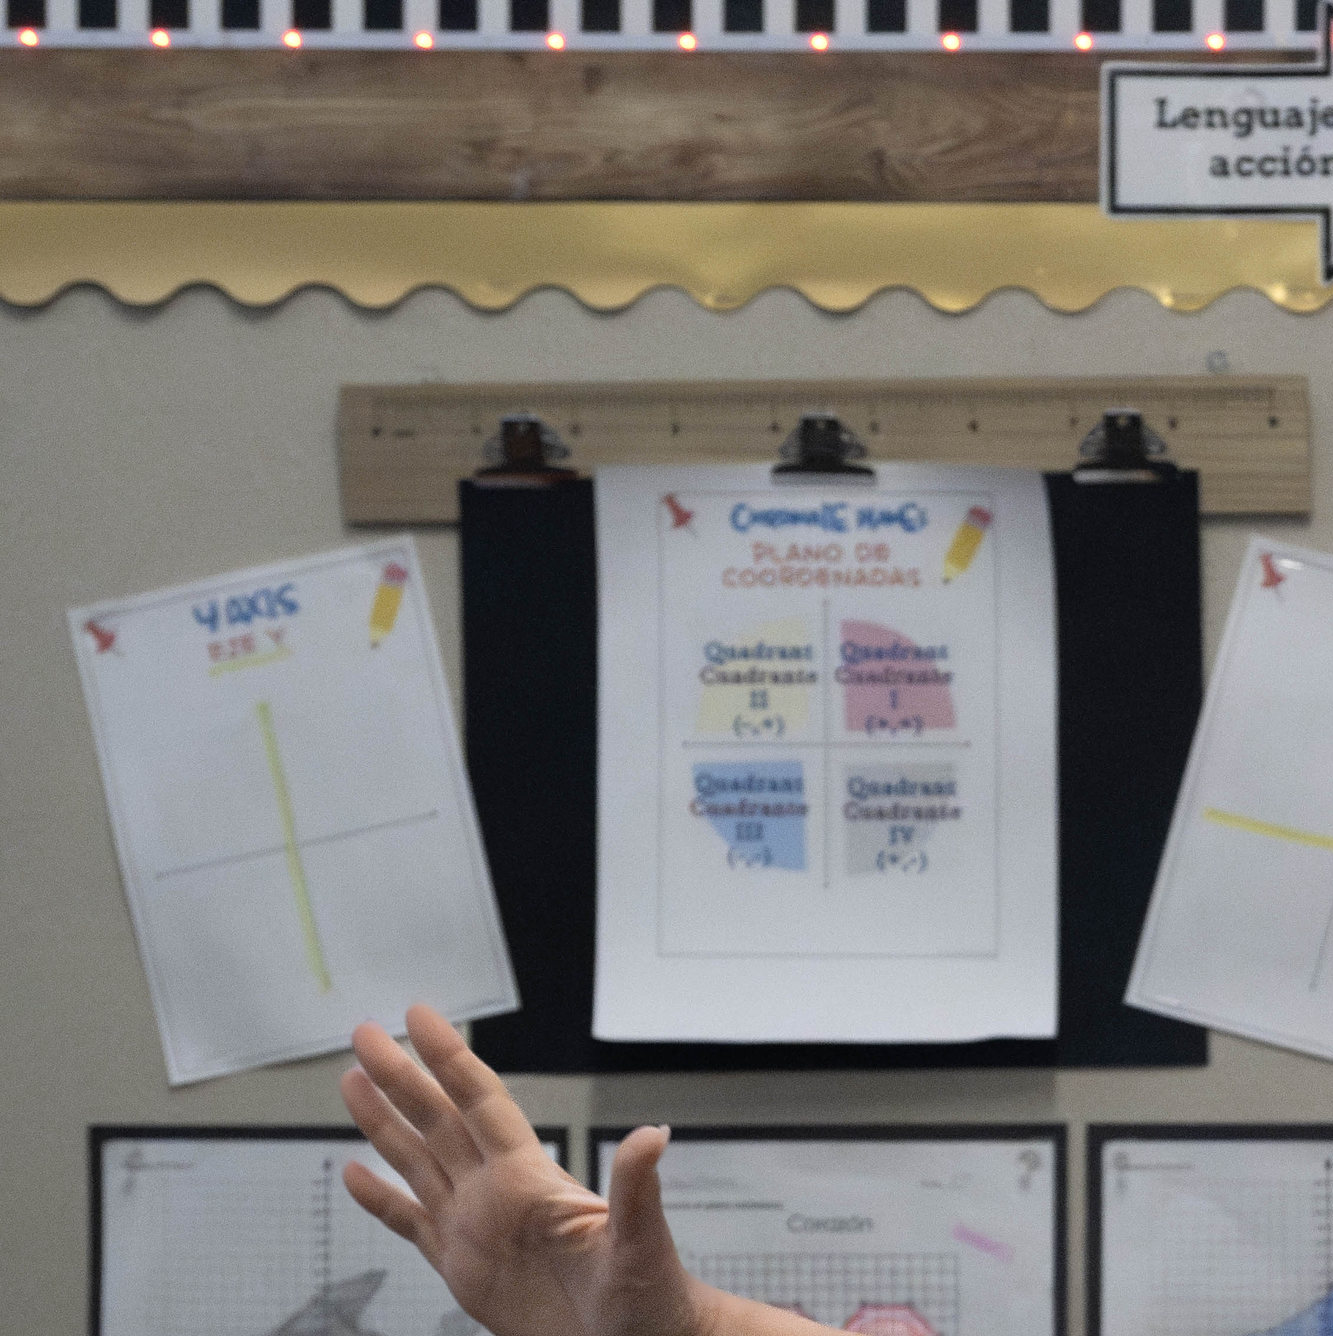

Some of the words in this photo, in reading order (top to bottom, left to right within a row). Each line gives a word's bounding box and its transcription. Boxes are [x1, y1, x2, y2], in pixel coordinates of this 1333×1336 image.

[751, 541, 844, 563] PLANO
[703, 640, 814, 666] Quadrant
[839, 640, 949, 666] Quadrant
